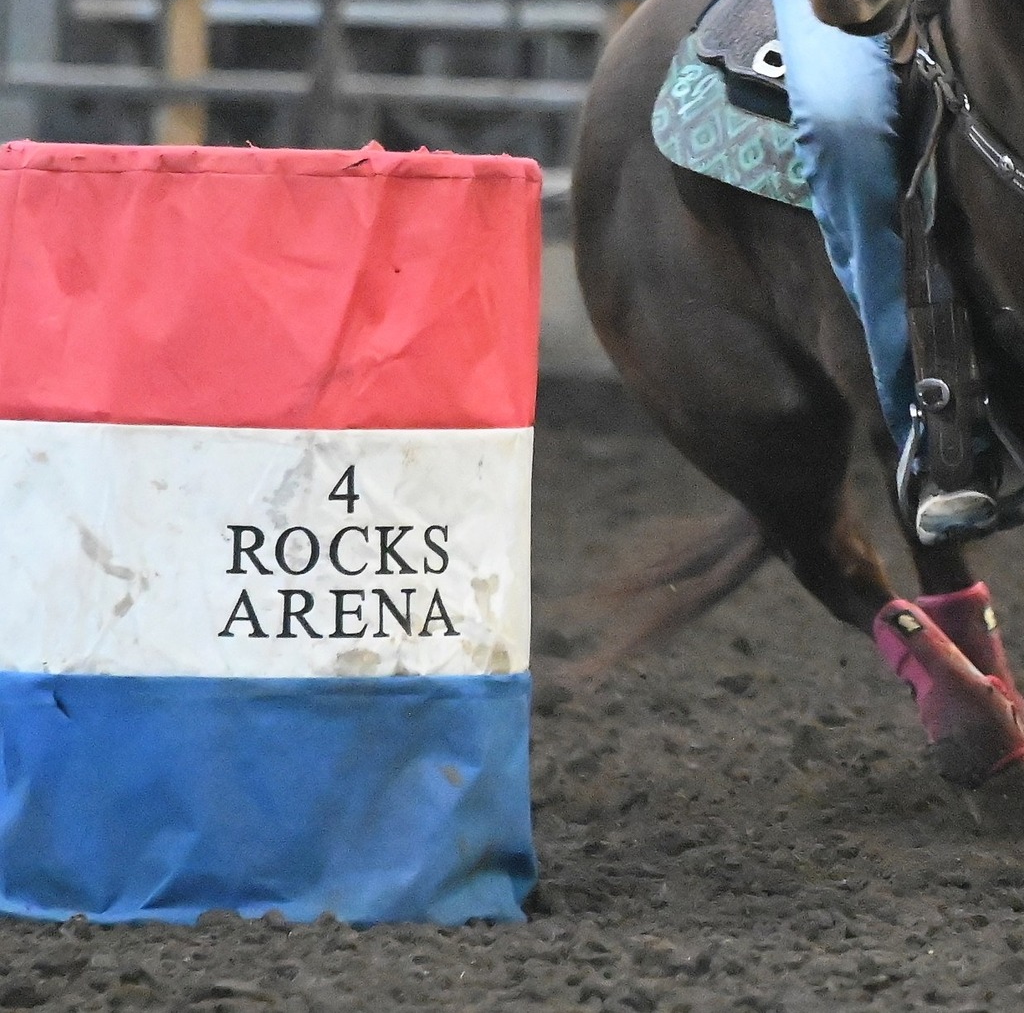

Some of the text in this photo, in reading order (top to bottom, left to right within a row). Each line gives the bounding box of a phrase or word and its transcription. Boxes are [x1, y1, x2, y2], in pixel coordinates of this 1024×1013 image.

[328, 464, 360, 514] 4
[225, 524, 450, 576] ROCKS
[217, 588, 461, 639] ARENA
